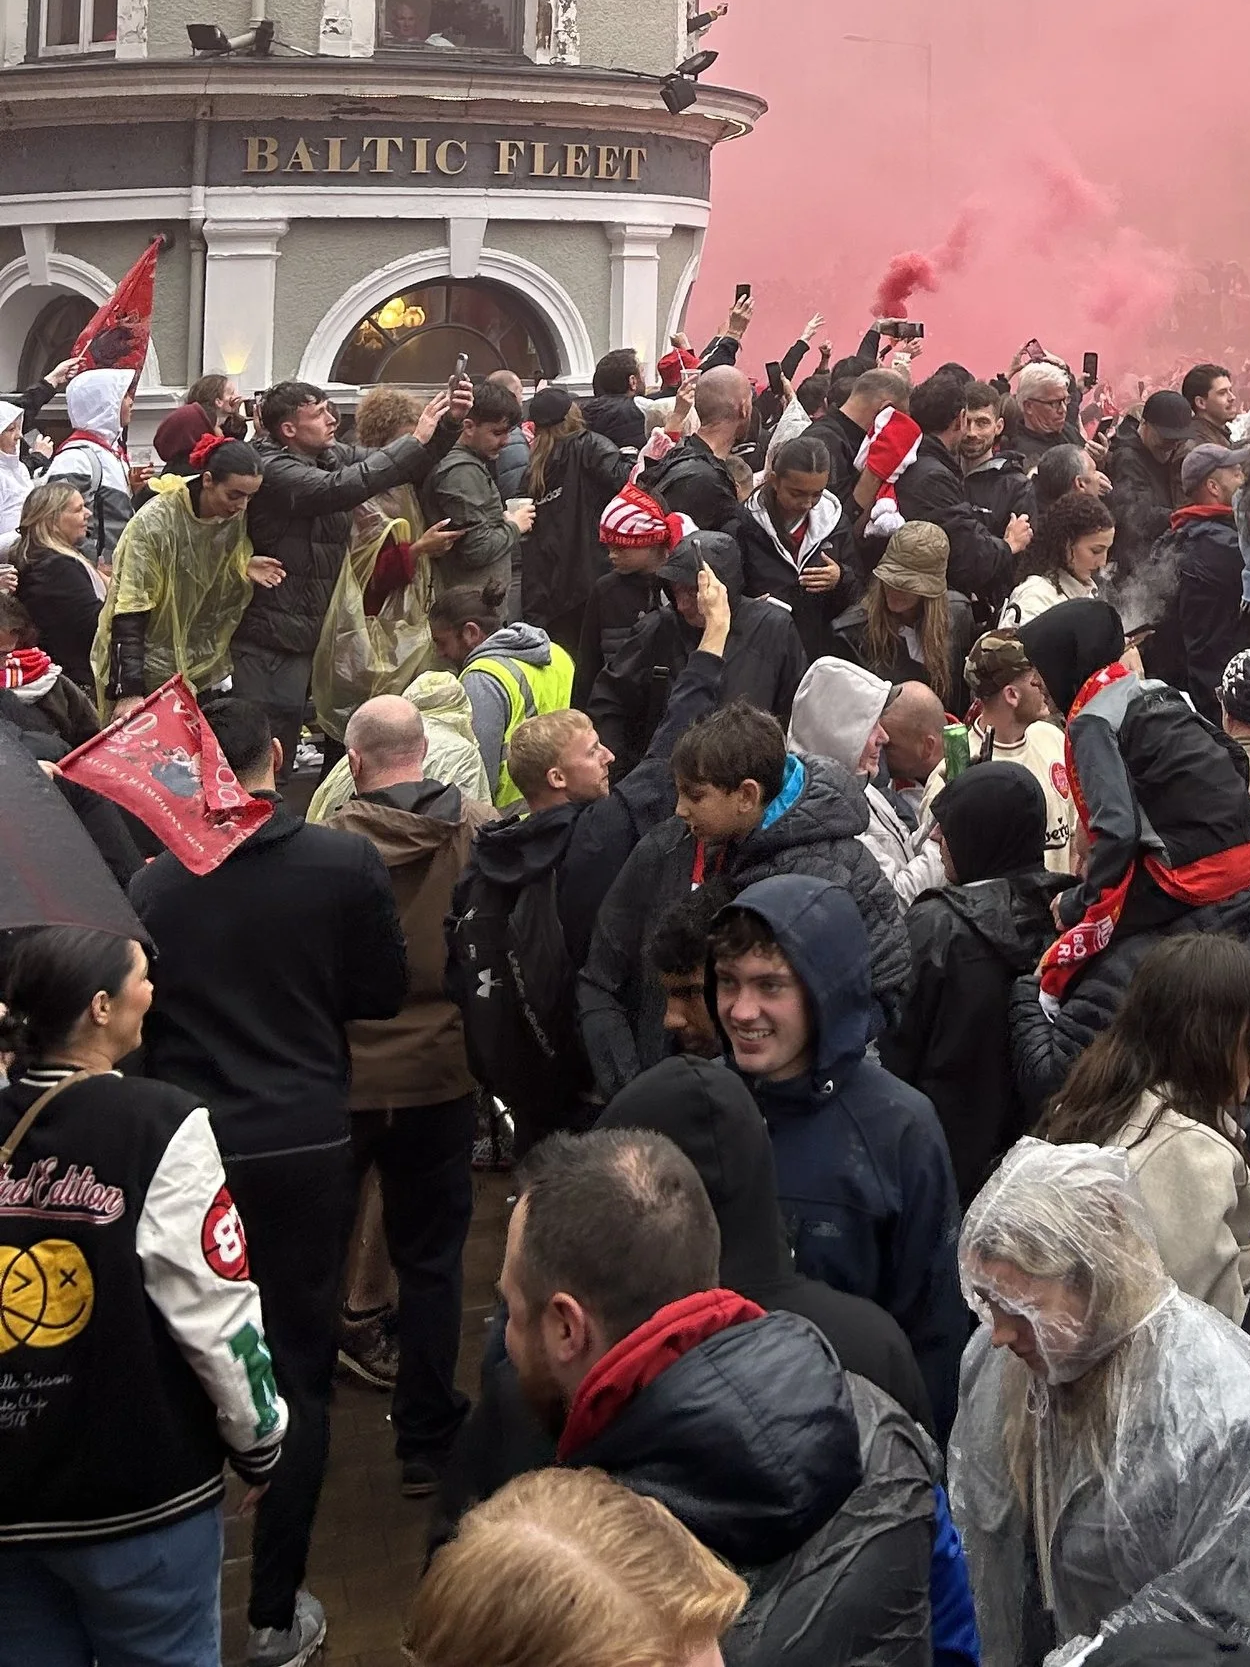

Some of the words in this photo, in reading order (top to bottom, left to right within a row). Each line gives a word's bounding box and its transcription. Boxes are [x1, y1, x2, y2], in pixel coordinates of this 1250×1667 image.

[241, 136, 469, 175] BALTIC
[493, 139, 648, 181] FLEET
[33, 1156, 123, 1214] Edition
